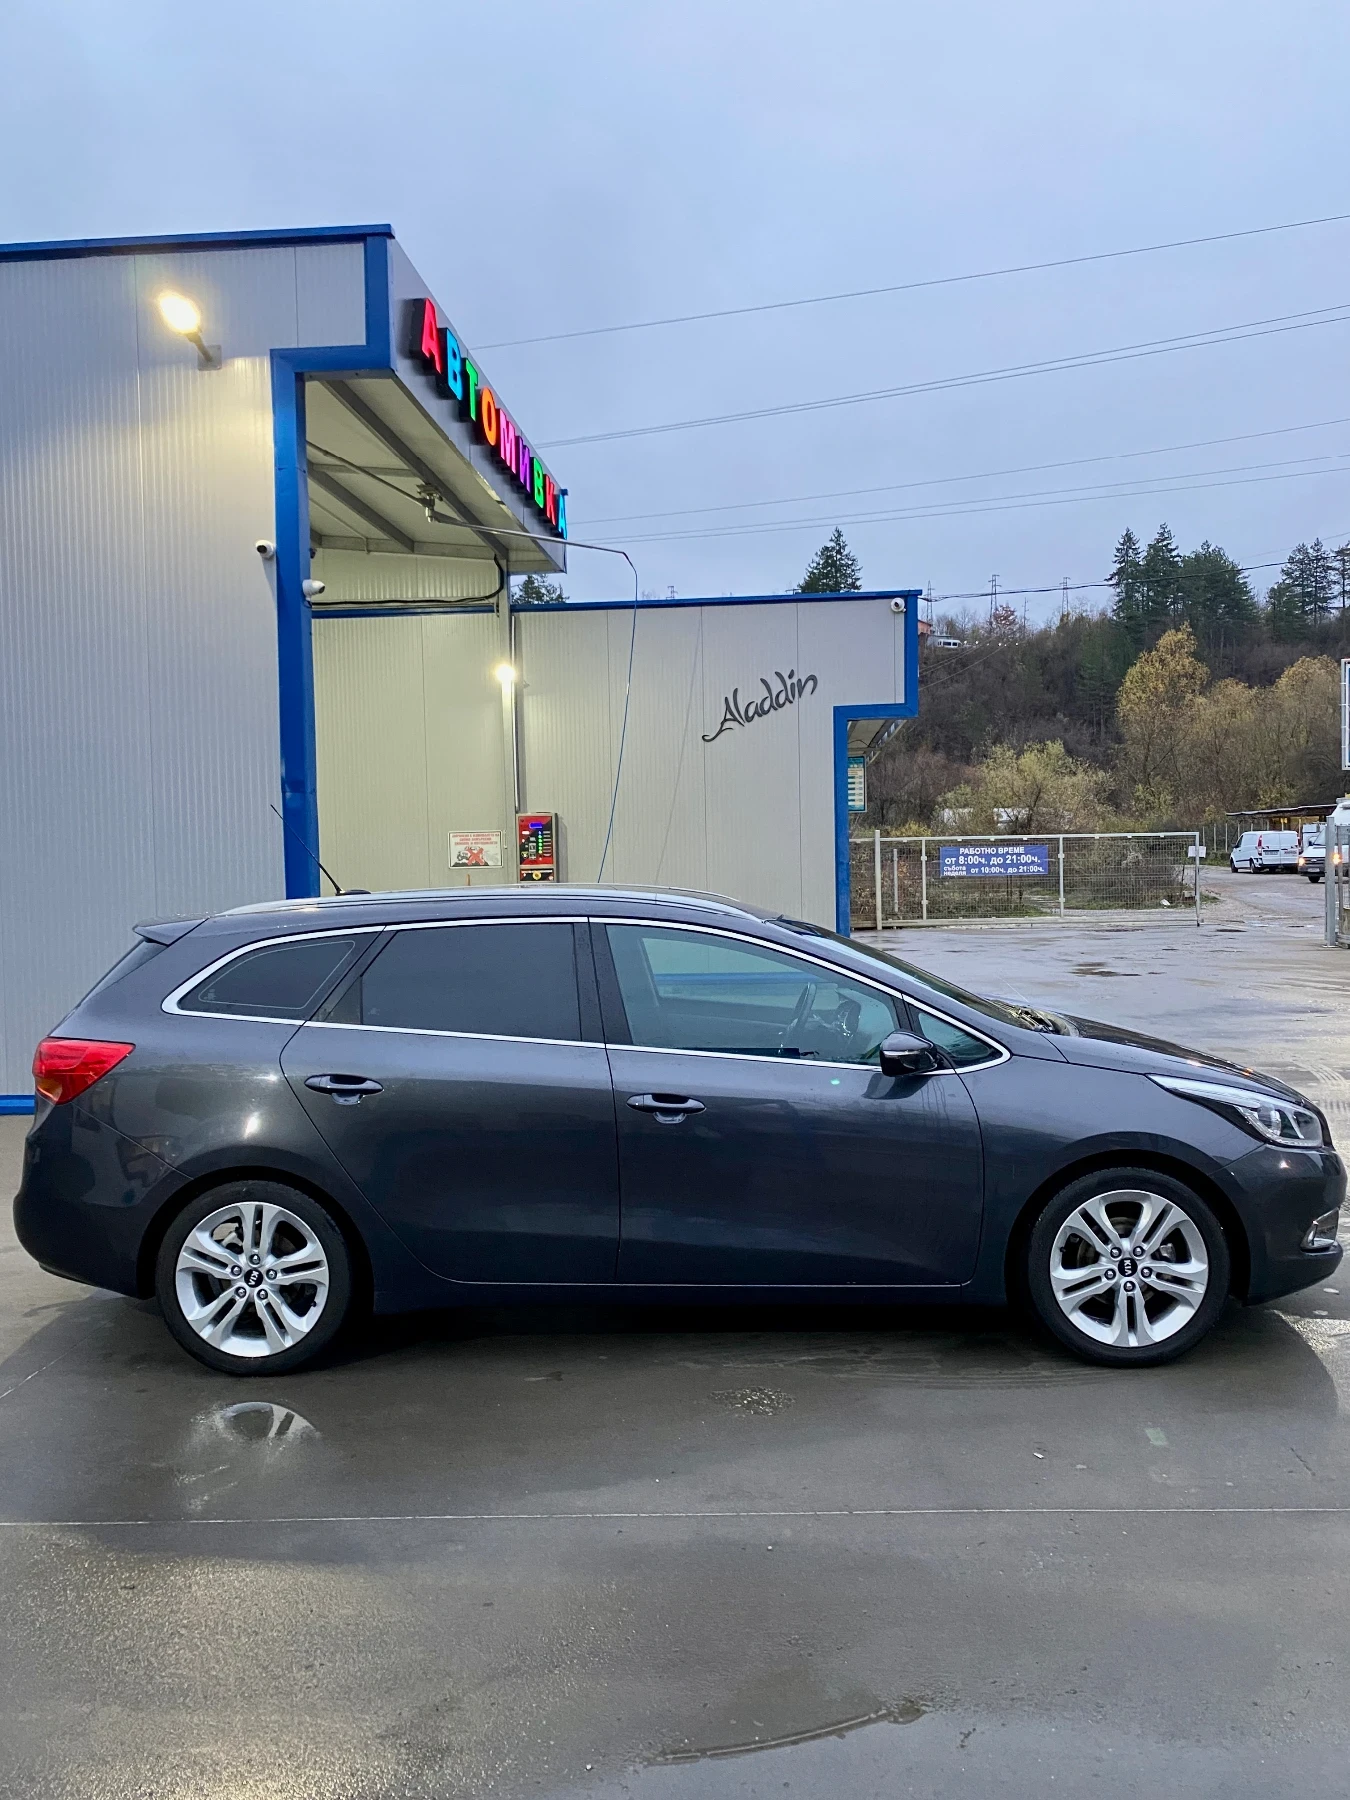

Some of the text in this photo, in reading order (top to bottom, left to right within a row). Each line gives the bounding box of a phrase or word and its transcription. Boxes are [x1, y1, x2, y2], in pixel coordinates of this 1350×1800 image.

[421, 297, 567, 540] АВТОМИВКА
[702, 669, 818, 743] Aladdin
[958, 856, 988, 864] 8:00ч.
[990, 857, 1003, 865] до
[1006, 855, 1041, 863] 21:00ч.
